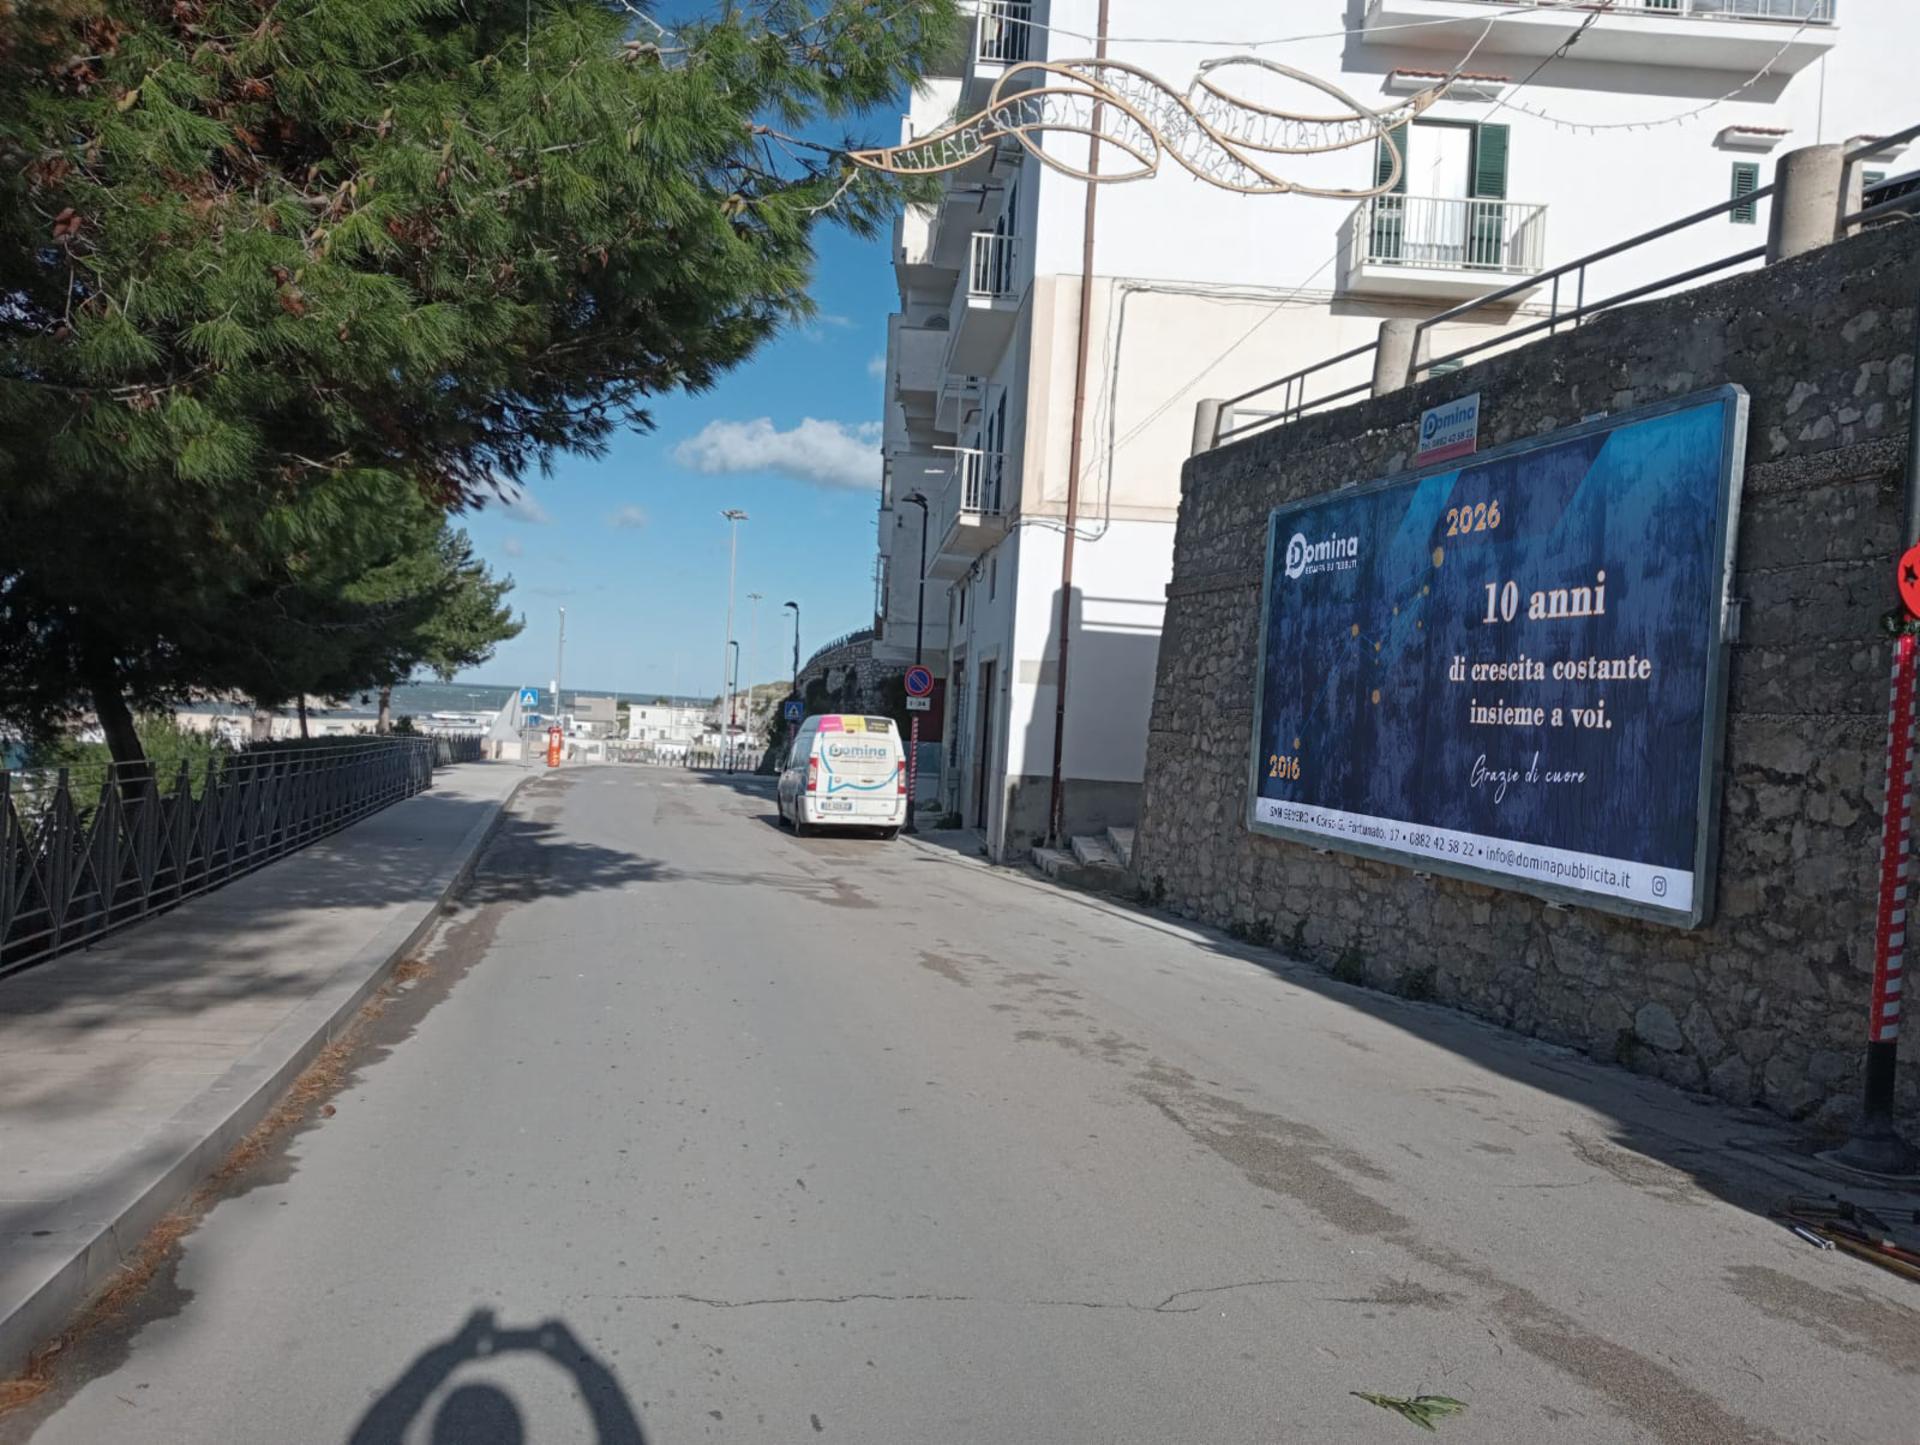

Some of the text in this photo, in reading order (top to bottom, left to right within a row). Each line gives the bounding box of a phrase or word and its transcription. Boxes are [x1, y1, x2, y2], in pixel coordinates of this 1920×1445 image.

[1423, 406, 1475, 440] Domina
[1446, 499, 1500, 537] 2026
[1285, 531, 1359, 580] Domina
[1482, 569, 1606, 624] 10 anni
[1449, 653, 1652, 682] di crescita costante
[1469, 698, 1613, 729] insieme a voi.
[828, 743, 887, 758] Domina
[1269, 754, 1301, 780] 2016
[1470, 751, 1587, 805] Grazie di cuore
[1409, 832, 1632, 890] 0882 42 58 22 info@dominapubblicita.it
